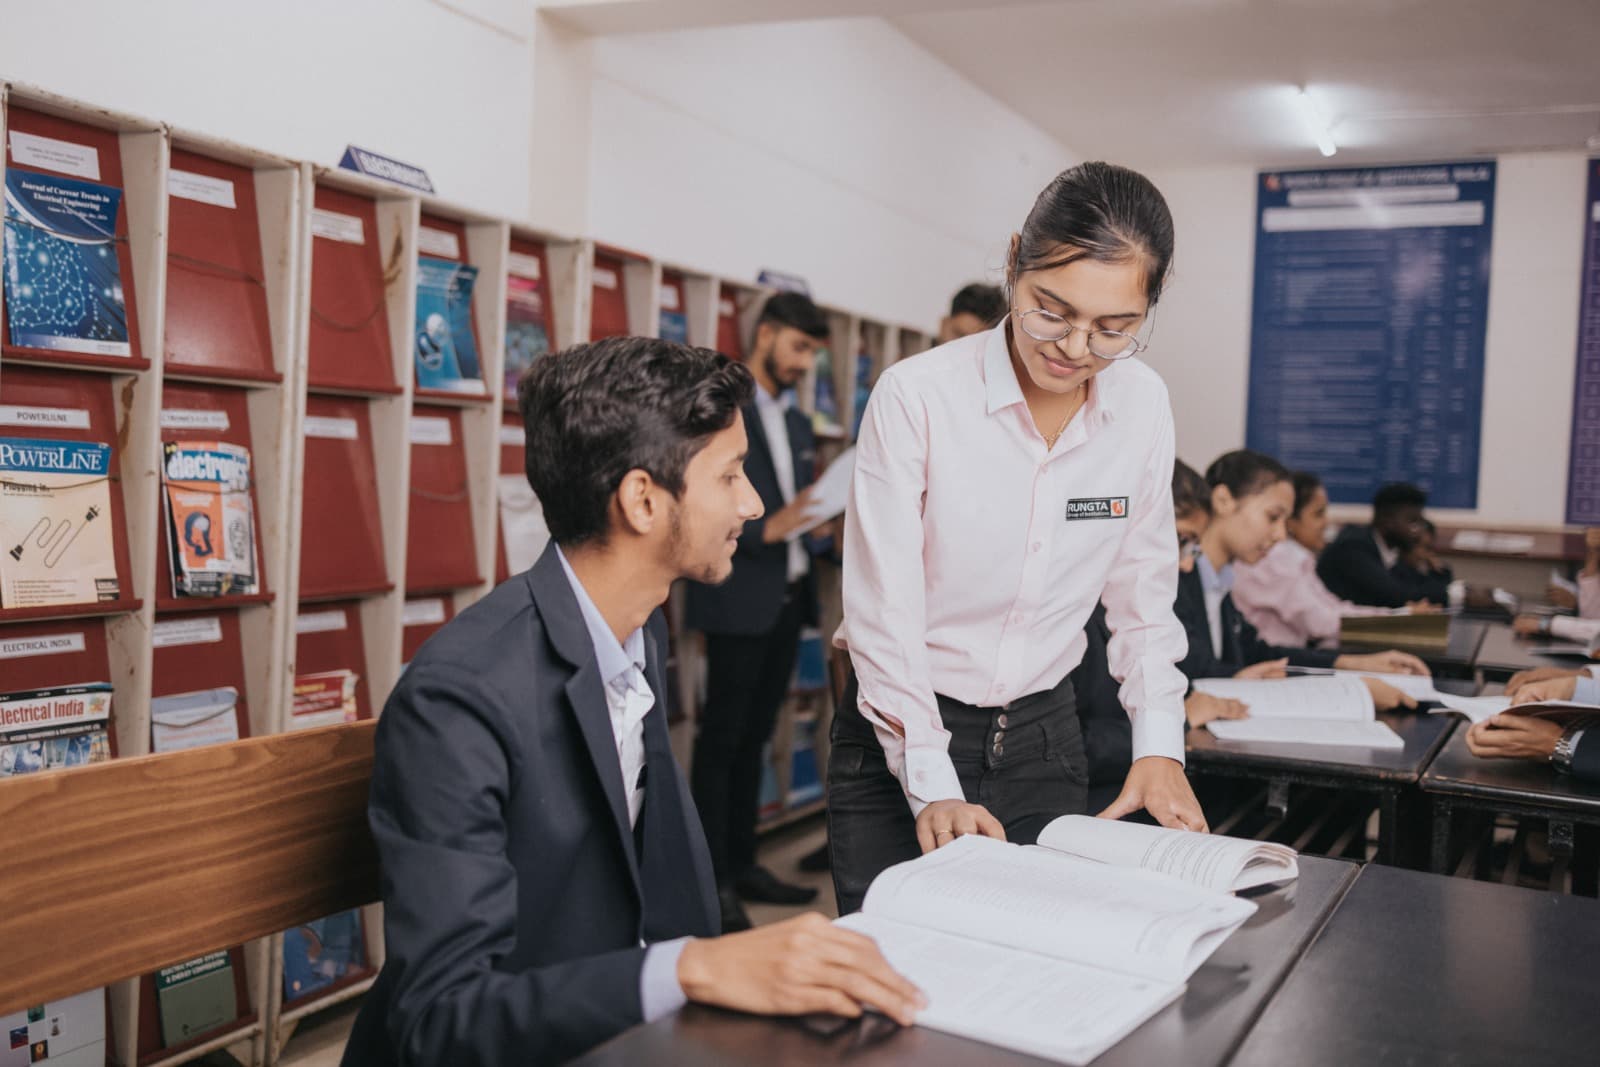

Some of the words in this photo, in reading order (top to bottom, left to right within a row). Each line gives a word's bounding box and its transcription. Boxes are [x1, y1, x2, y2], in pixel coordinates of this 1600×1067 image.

[54, 187, 79, 198] Current
[1067, 501, 1109, 512] RUNGTA
[3, 641, 48, 653] ELECTRICAL
[49, 639, 72, 649] INDIA
[0, 702, 51, 725] lectrical
[54, 699, 84, 718] India
